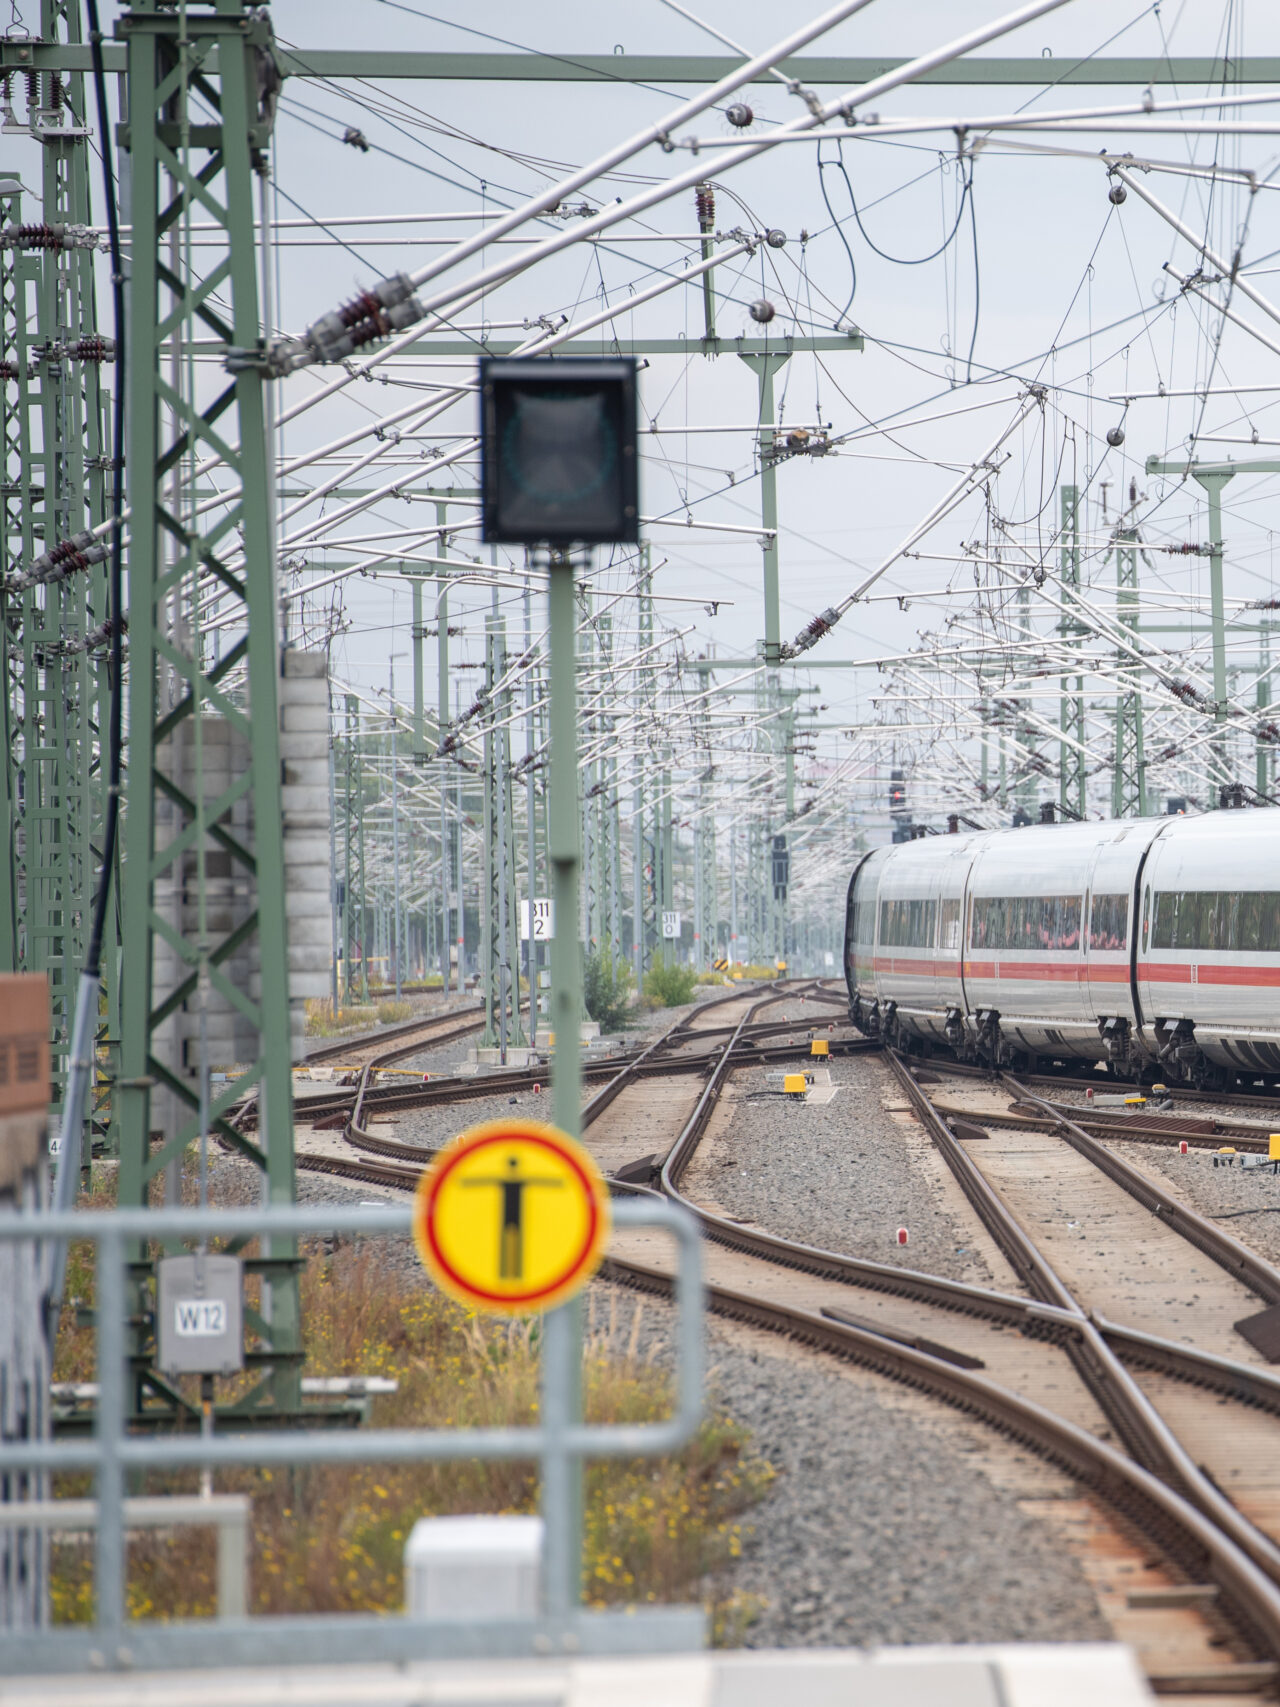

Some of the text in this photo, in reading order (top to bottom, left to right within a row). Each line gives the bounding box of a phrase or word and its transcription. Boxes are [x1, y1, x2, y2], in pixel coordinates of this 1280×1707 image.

[663, 912, 676, 924] 311
[534, 919, 544, 935] 2
[178, 1305, 223, 1331] W12
